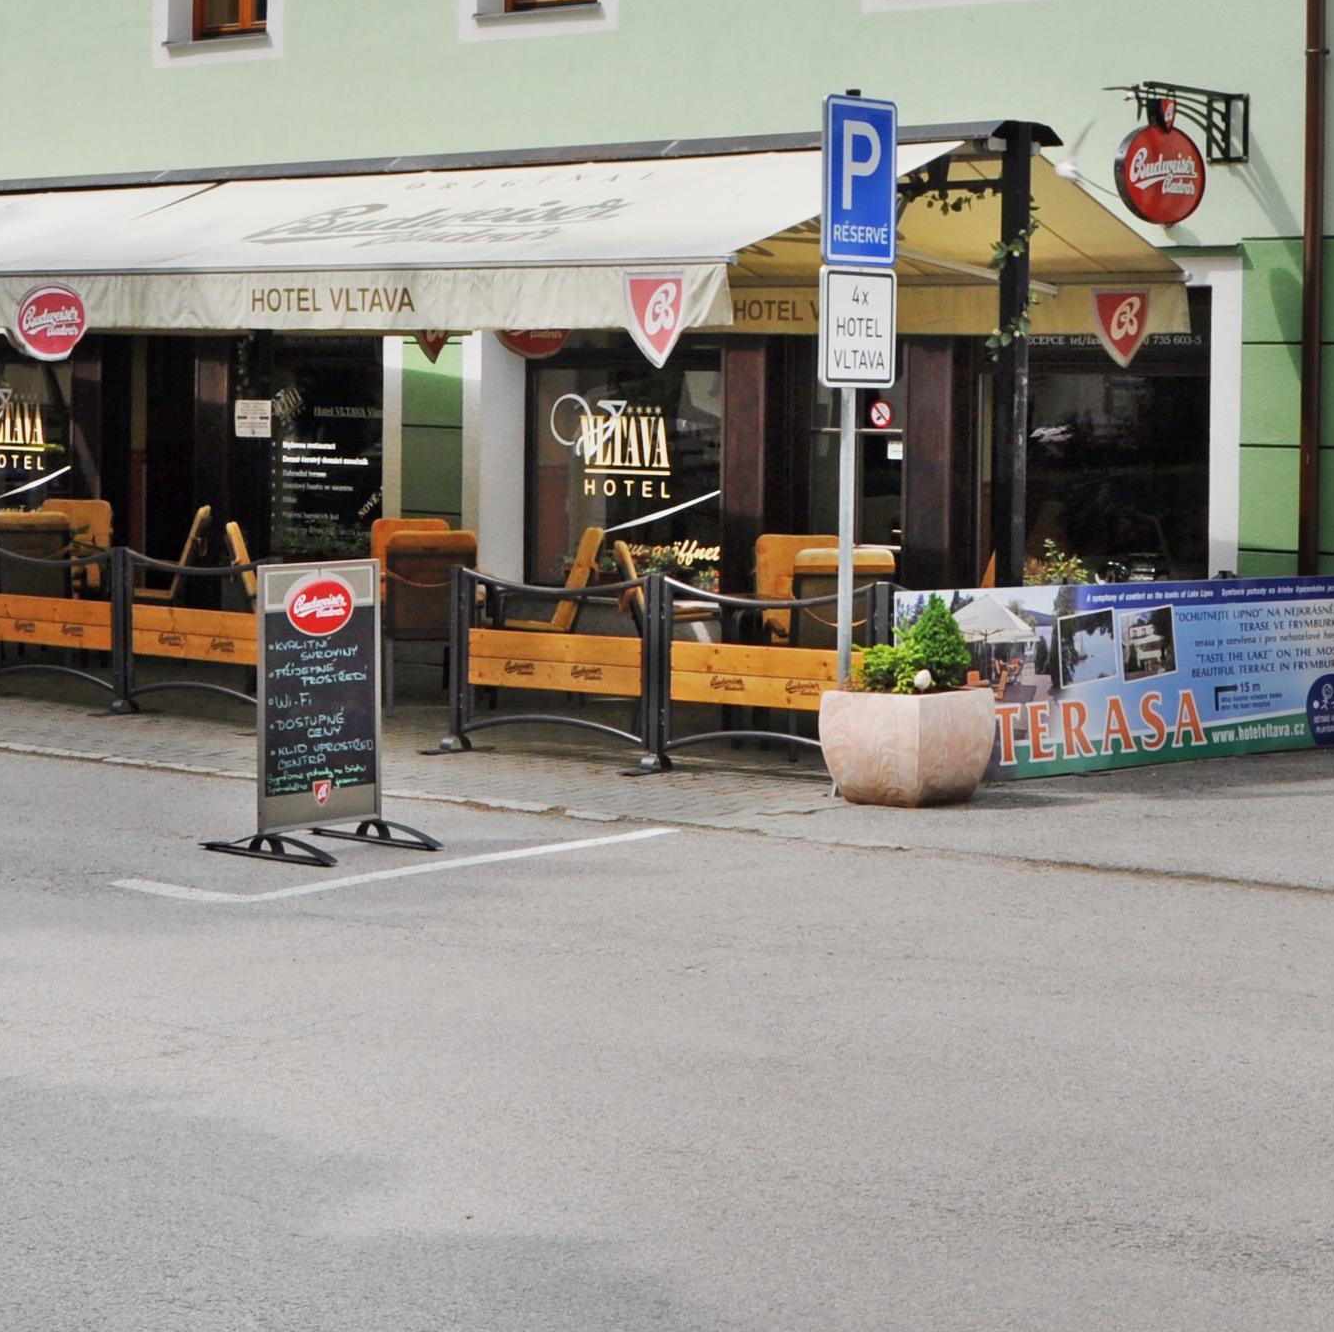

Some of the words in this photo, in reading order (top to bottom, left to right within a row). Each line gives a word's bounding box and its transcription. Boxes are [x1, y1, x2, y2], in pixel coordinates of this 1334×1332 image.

[842, 119, 882, 210] P
[1130, 148, 1198, 189] Budweiser
[833, 221, 889, 245] RÉSERVÉ
[251, 288, 323, 313] HOTEL
[329, 287, 415, 313] VLTAVA
[852, 286, 870, 305] 4x
[22, 305, 81, 335] Budweiser
[733, 299, 803, 322] HOTEL
[836, 318, 883, 339] HOTEL
[834, 349, 885, 370] VLTAVA
[580, 415, 671, 468] VLTAVA
[584, 479, 671, 499] HOTEL
[1267, 608, 1280, 618] NA
[1239, 621, 1270, 632] TERASE
[1273, 621, 1285, 631] VE
[275, 636, 332, 651] KVALITNÍ
[1195, 639, 1215, 648] terasa
[1217, 638, 1225, 649] je
[1226, 635, 1256, 646] otevřena
[1264, 635, 1277, 646] pro
[1279, 631, 1321, 642] nehotelové
[300, 645, 358, 661] SUROVINY
[1228, 651, 1245, 661] THE
[1276, 648, 1291, 659] ON
[1295, 647, 1312, 657] THE
[1191, 667, 1236, 678] BEAUTIFUL
[1239, 664, 1276, 674] TERRACE
[1279, 663, 1290, 672] IN
[1240, 682, 1250, 693] 15
[1252, 683, 1261, 692] m
[276, 710, 345, 730] DOSTUPNÉ
[995, 688, 1207, 766] TERASA
[307, 725, 342, 738] CENY
[1211, 722, 1306, 744] www.hotelvltava.cz
[278, 743, 308, 756] KLID
[277, 753, 326, 770] CENTRA
